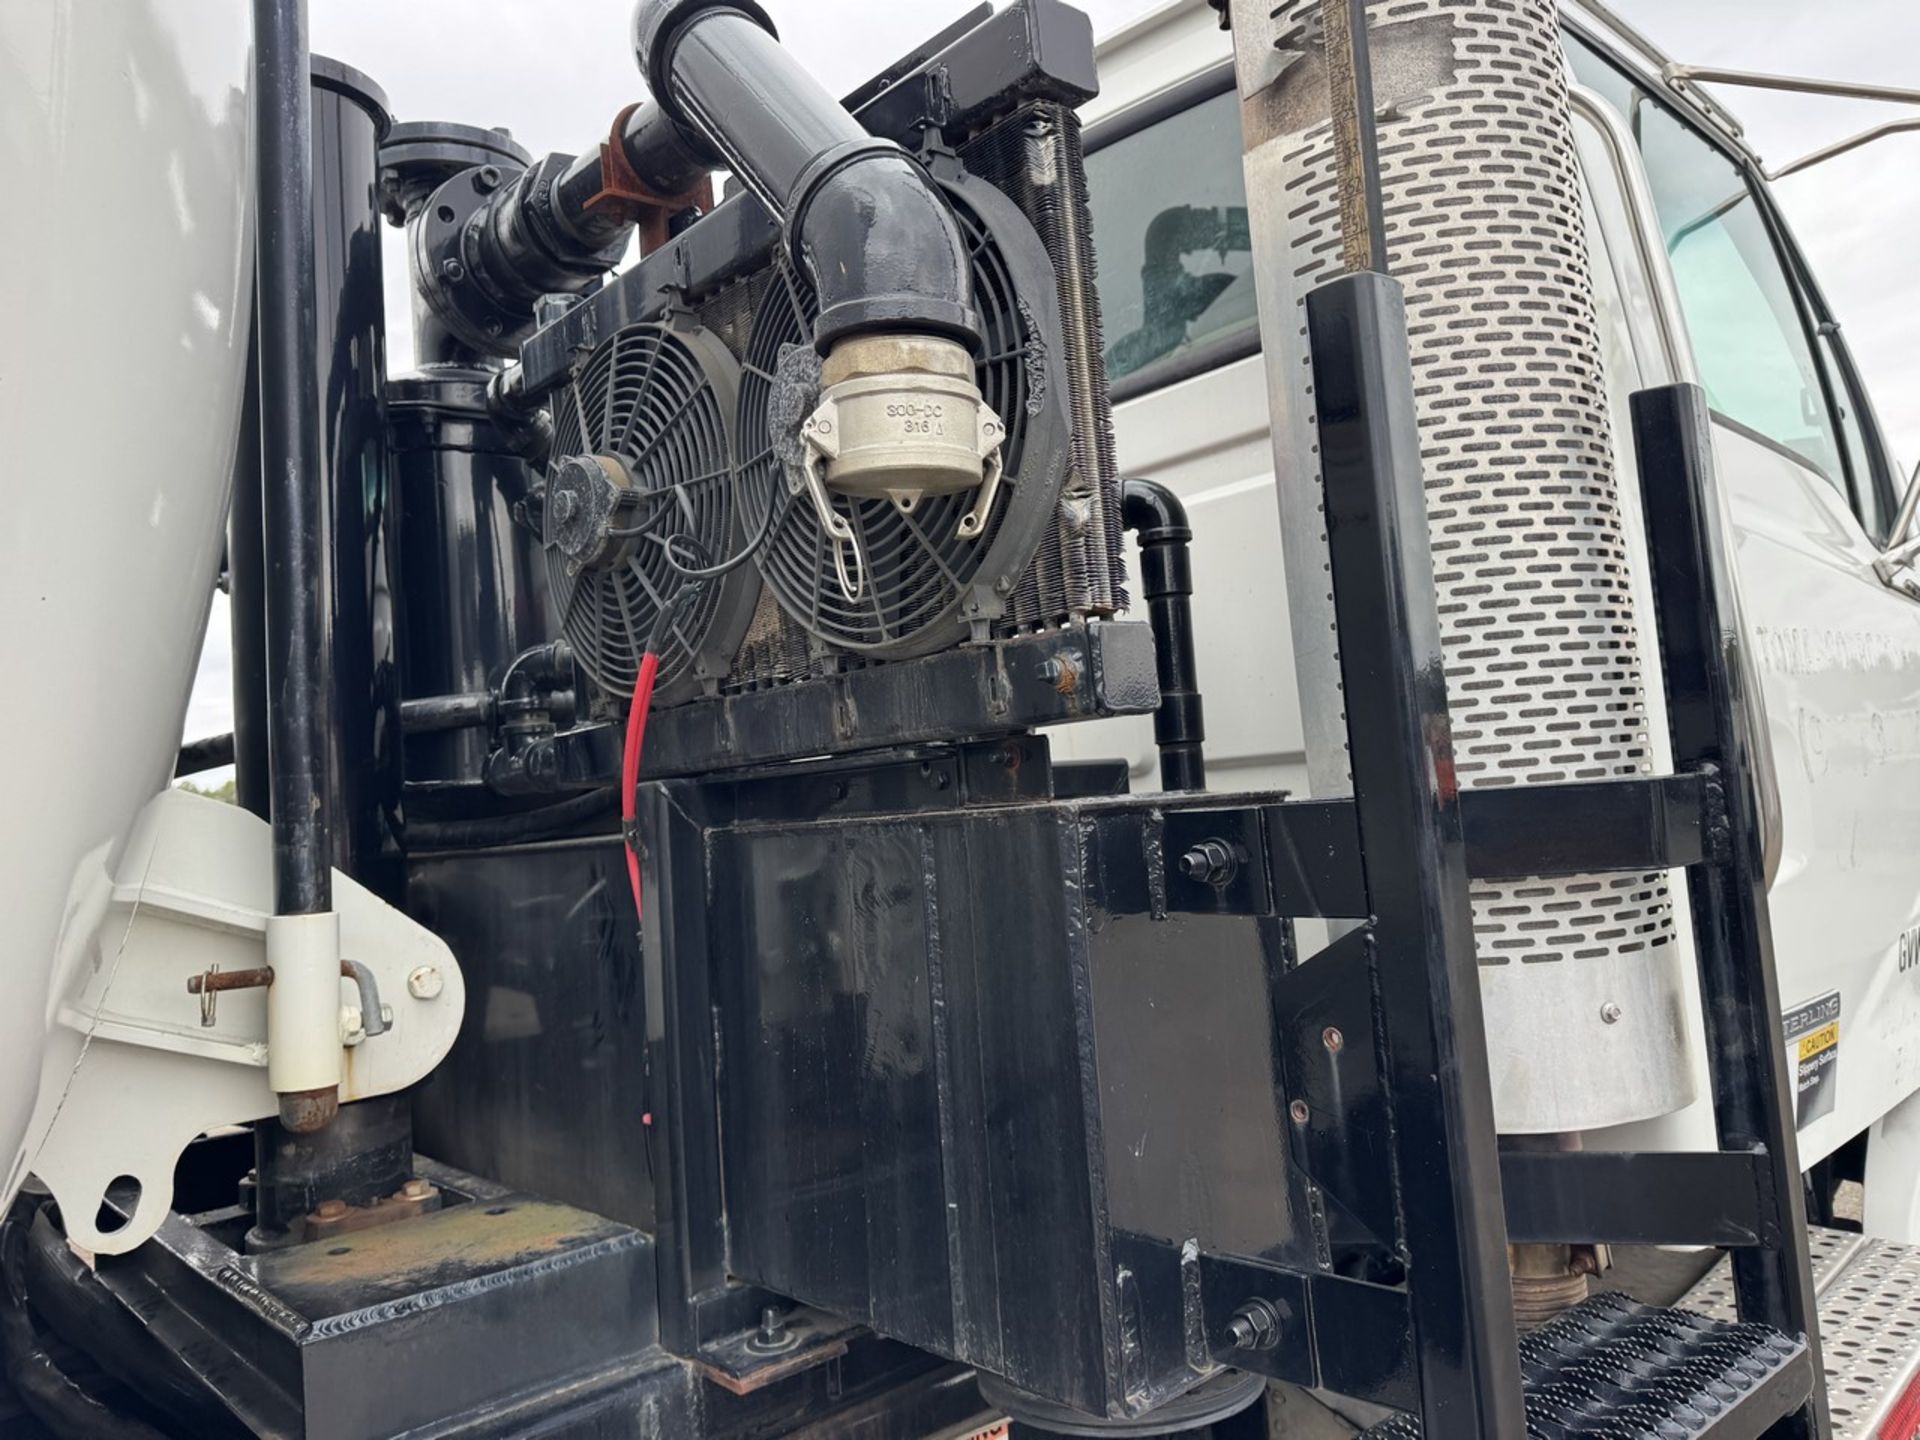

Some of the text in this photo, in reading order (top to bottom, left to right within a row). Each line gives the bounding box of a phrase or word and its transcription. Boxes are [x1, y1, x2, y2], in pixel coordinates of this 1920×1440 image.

[904, 420, 930, 433] 316
[1781, 998, 1839, 1036] TERLING
[1805, 1030, 1835, 1054] CAUTION
